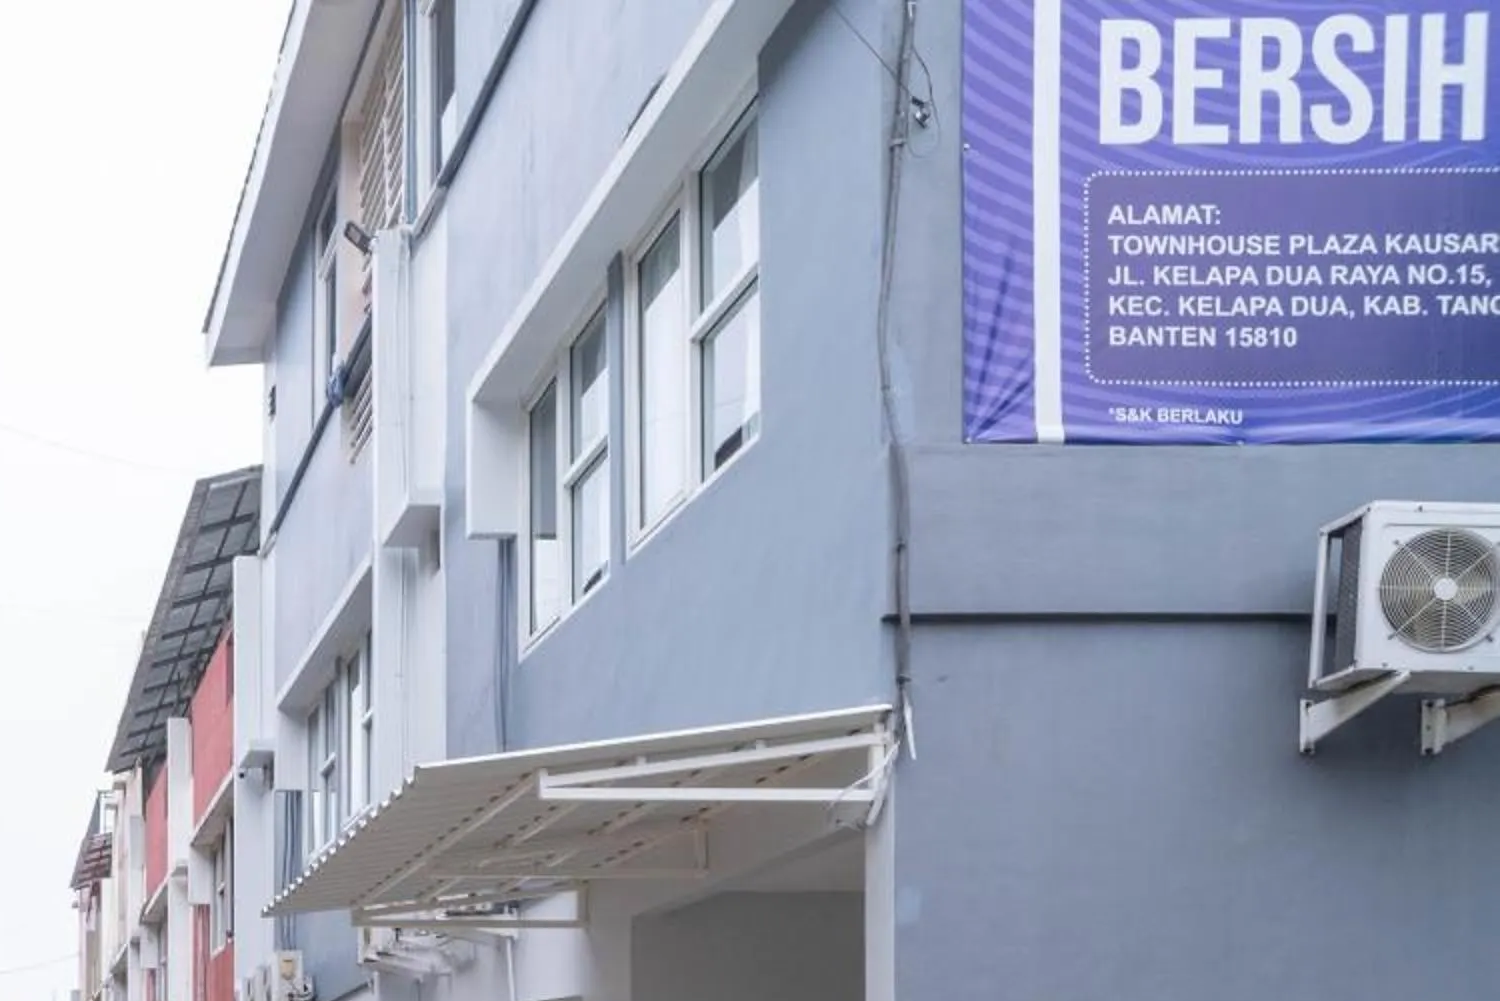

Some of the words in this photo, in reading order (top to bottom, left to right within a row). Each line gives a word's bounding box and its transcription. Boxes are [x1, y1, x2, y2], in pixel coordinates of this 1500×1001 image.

[1100, 12, 1489, 145] BERSIH
[1108, 204, 1221, 226] ALAMAT:
[1108, 234, 1281, 256] TOWNHOUSE
[1289, 234, 1378, 255] PLAZA
[1385, 233, 1499, 254] KAUSAR
[1108, 265, 1145, 286] JL.
[1153, 265, 1259, 286] KELAPA
[1266, 265, 1322, 286] DUA
[1330, 264, 1400, 285] RAYA
[1407, 264, 1492, 288] NO.15,
[1108, 295, 1169, 317] KEC.
[1178, 295, 1284, 317] KELAPA
[1291, 295, 1355, 319] DUA,
[1363, 295, 1428, 316] KAB.
[1108, 326, 1217, 347] BANTEN
[1225, 327, 1297, 348] 15810
[1157, 408, 1243, 425] BERLAKU
